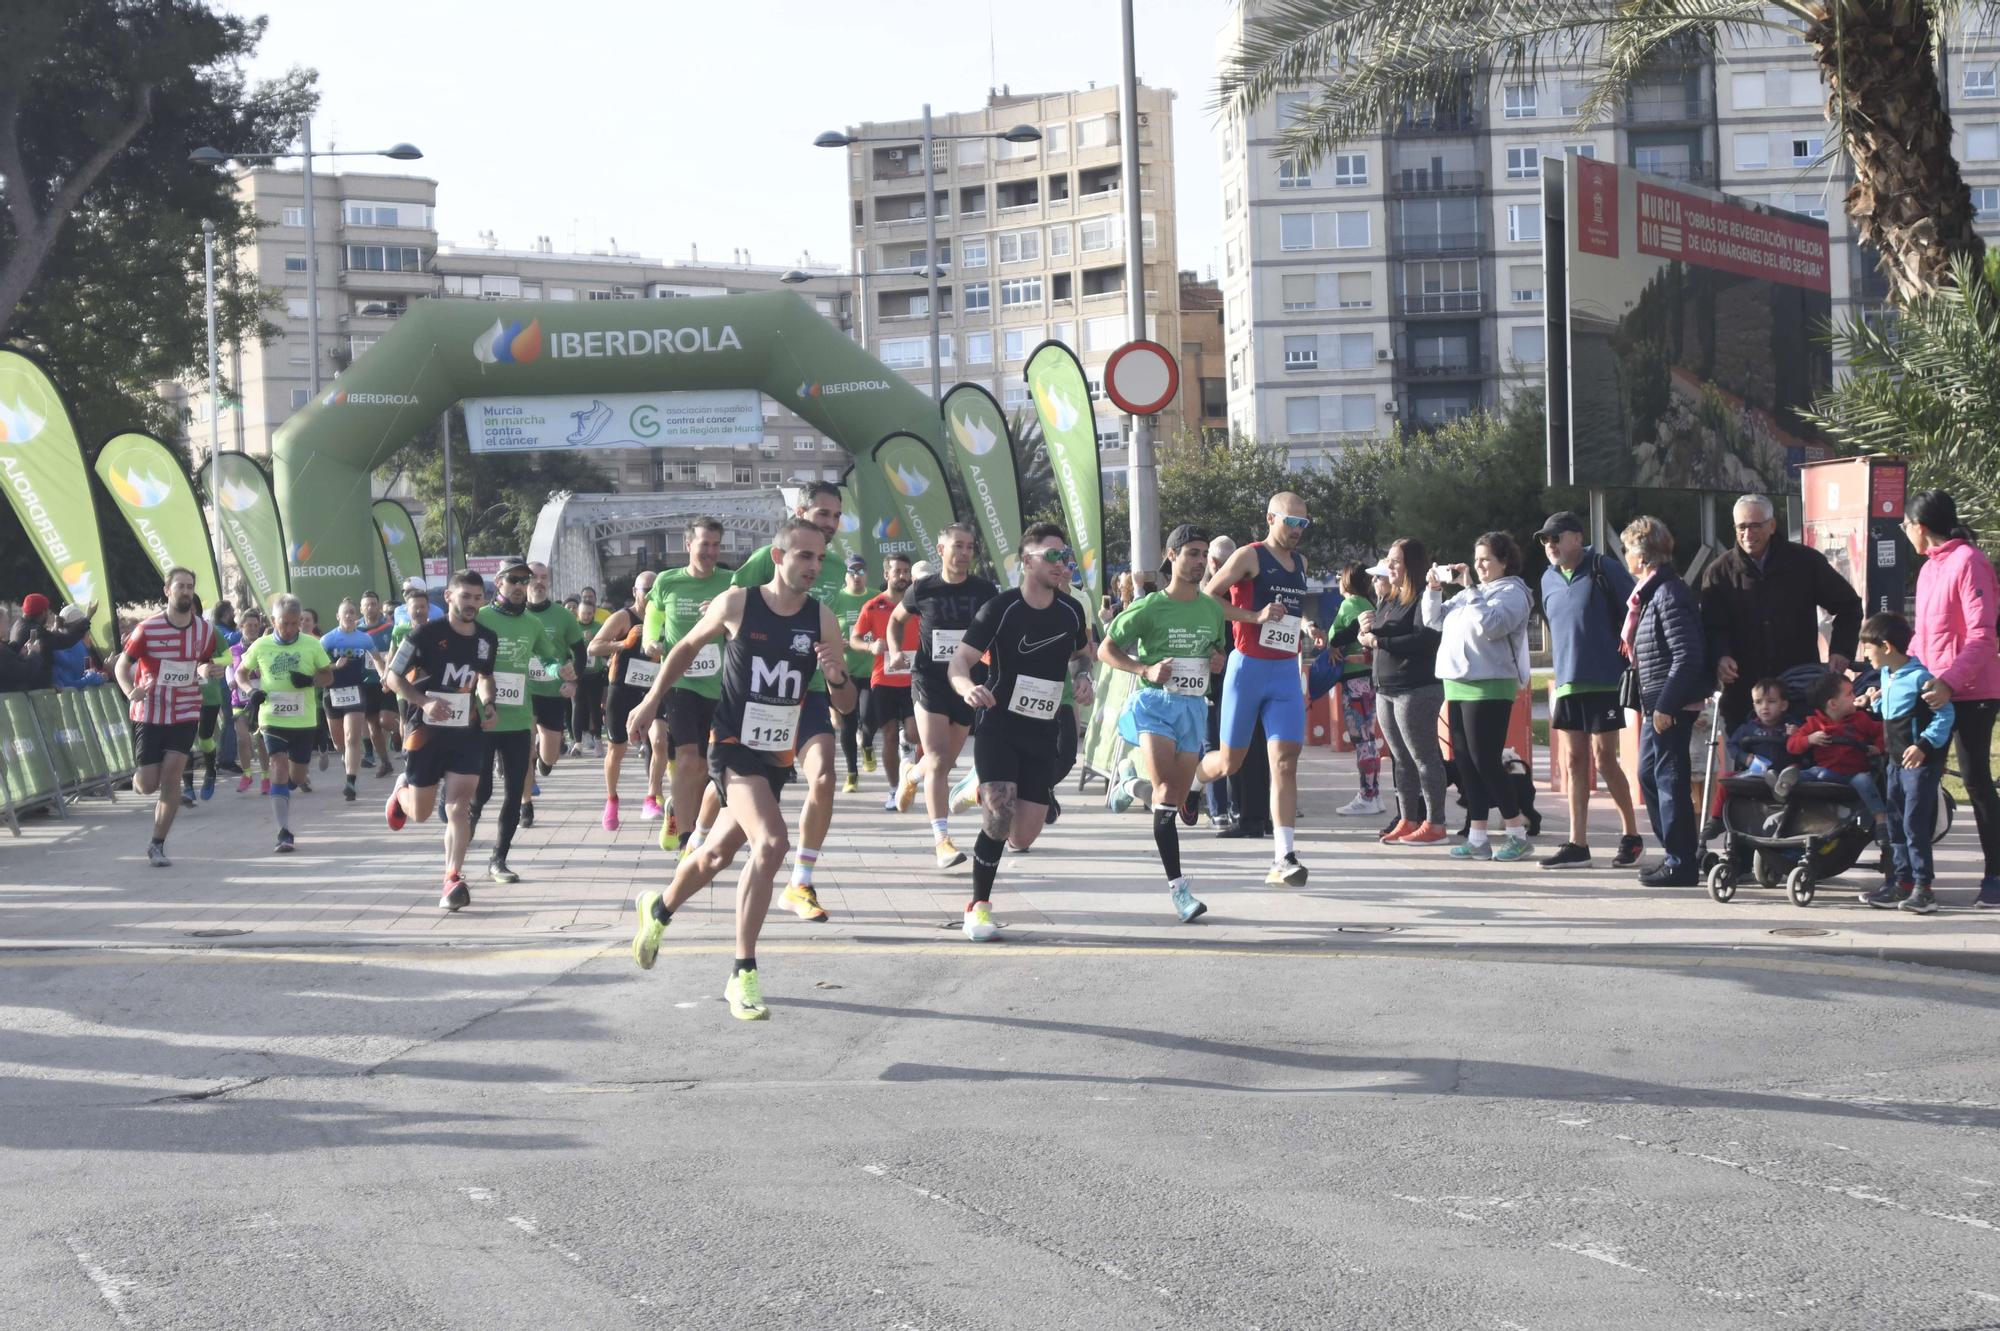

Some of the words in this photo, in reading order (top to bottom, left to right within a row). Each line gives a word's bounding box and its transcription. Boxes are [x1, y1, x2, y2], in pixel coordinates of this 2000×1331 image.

[1641, 192, 1682, 224] MURCIA
[1641, 221, 1660, 248] RIO
[1717, 218, 1728, 235] DE
[1730, 222, 1787, 249] REVEGETACIÓN
[1787, 236, 1793, 251] Y
[1794, 238, 1824, 257] MEJORA
[1688, 233, 1699, 250] DE
[1701, 237, 1717, 254] LOS
[1718, 240, 1762, 264] MÁRGENES
[1763, 251, 1777, 268] DEL
[1779, 252, 1792, 271] RÍO
[551, 325, 742, 358] IBERDROLA
[822, 380, 890, 395] IBERDROLA
[347, 393, 418, 405] IBERDROLA
[483, 406, 523, 416] Murcia
[484, 417, 499, 426] en
[501, 415, 546, 425] marcha
[667, 417, 694, 425] contra
[696, 416, 705, 424] el
[485, 427, 522, 436] contra
[667, 427, 678, 435] en
[680, 426, 688, 434] la
[722, 425, 733, 433] de
[486, 437, 497, 446] el
[499, 436, 539, 446] cáncer
[880, 541, 917, 553] IBERD
[290, 564, 360, 577] IBERDROLA
[1267, 629, 1295, 644] 2305
[164, 673, 190, 682] 0709
[750, 656, 801, 699] Mh
[273, 703, 299, 712] 2203
[1020, 695, 1055, 712] 0758
[752, 727, 790, 742] 1126
